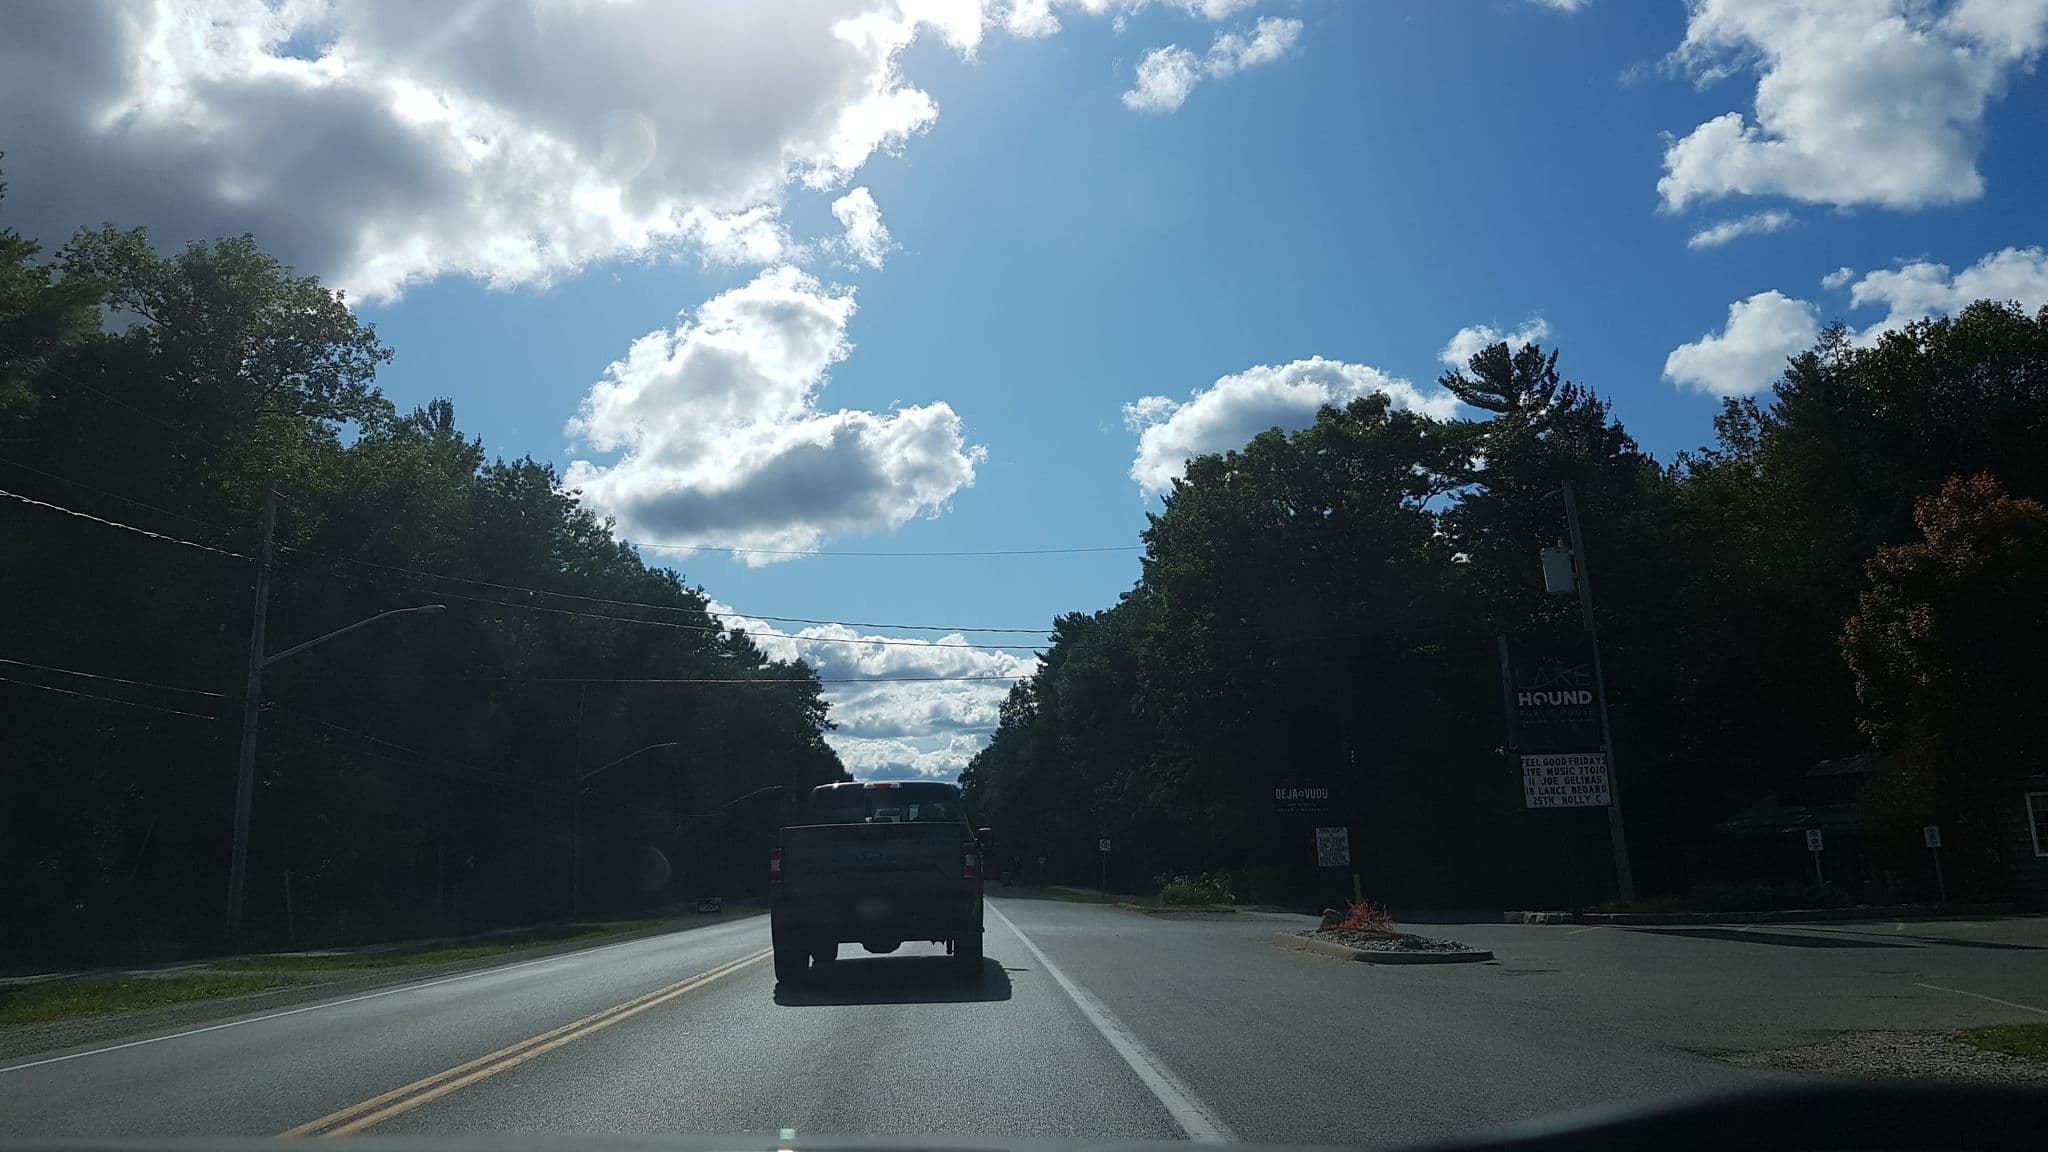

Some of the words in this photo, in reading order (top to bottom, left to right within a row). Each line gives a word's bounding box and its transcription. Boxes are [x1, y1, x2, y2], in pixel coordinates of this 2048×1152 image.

[1515, 664, 1592, 689] LAKE
[1518, 690, 1592, 707] HOUND
[1520, 758, 1541, 767] FEEL
[1543, 757, 1567, 766] GOOD
[1568, 756, 1607, 765] FRIDAYS
[1521, 768, 1541, 777] LIVE
[1546, 767, 1575, 776] MUSIC
[1541, 777, 1560, 786] JOE
[1564, 776, 1602, 785] GELINAS
[1538, 786, 1567, 796] LANCE
[1571, 785, 1607, 795] BEDARD
[1532, 796, 1554, 805] 25TH
[1562, 795, 1591, 804] HOLLY
[1595, 795, 1601, 803] C
